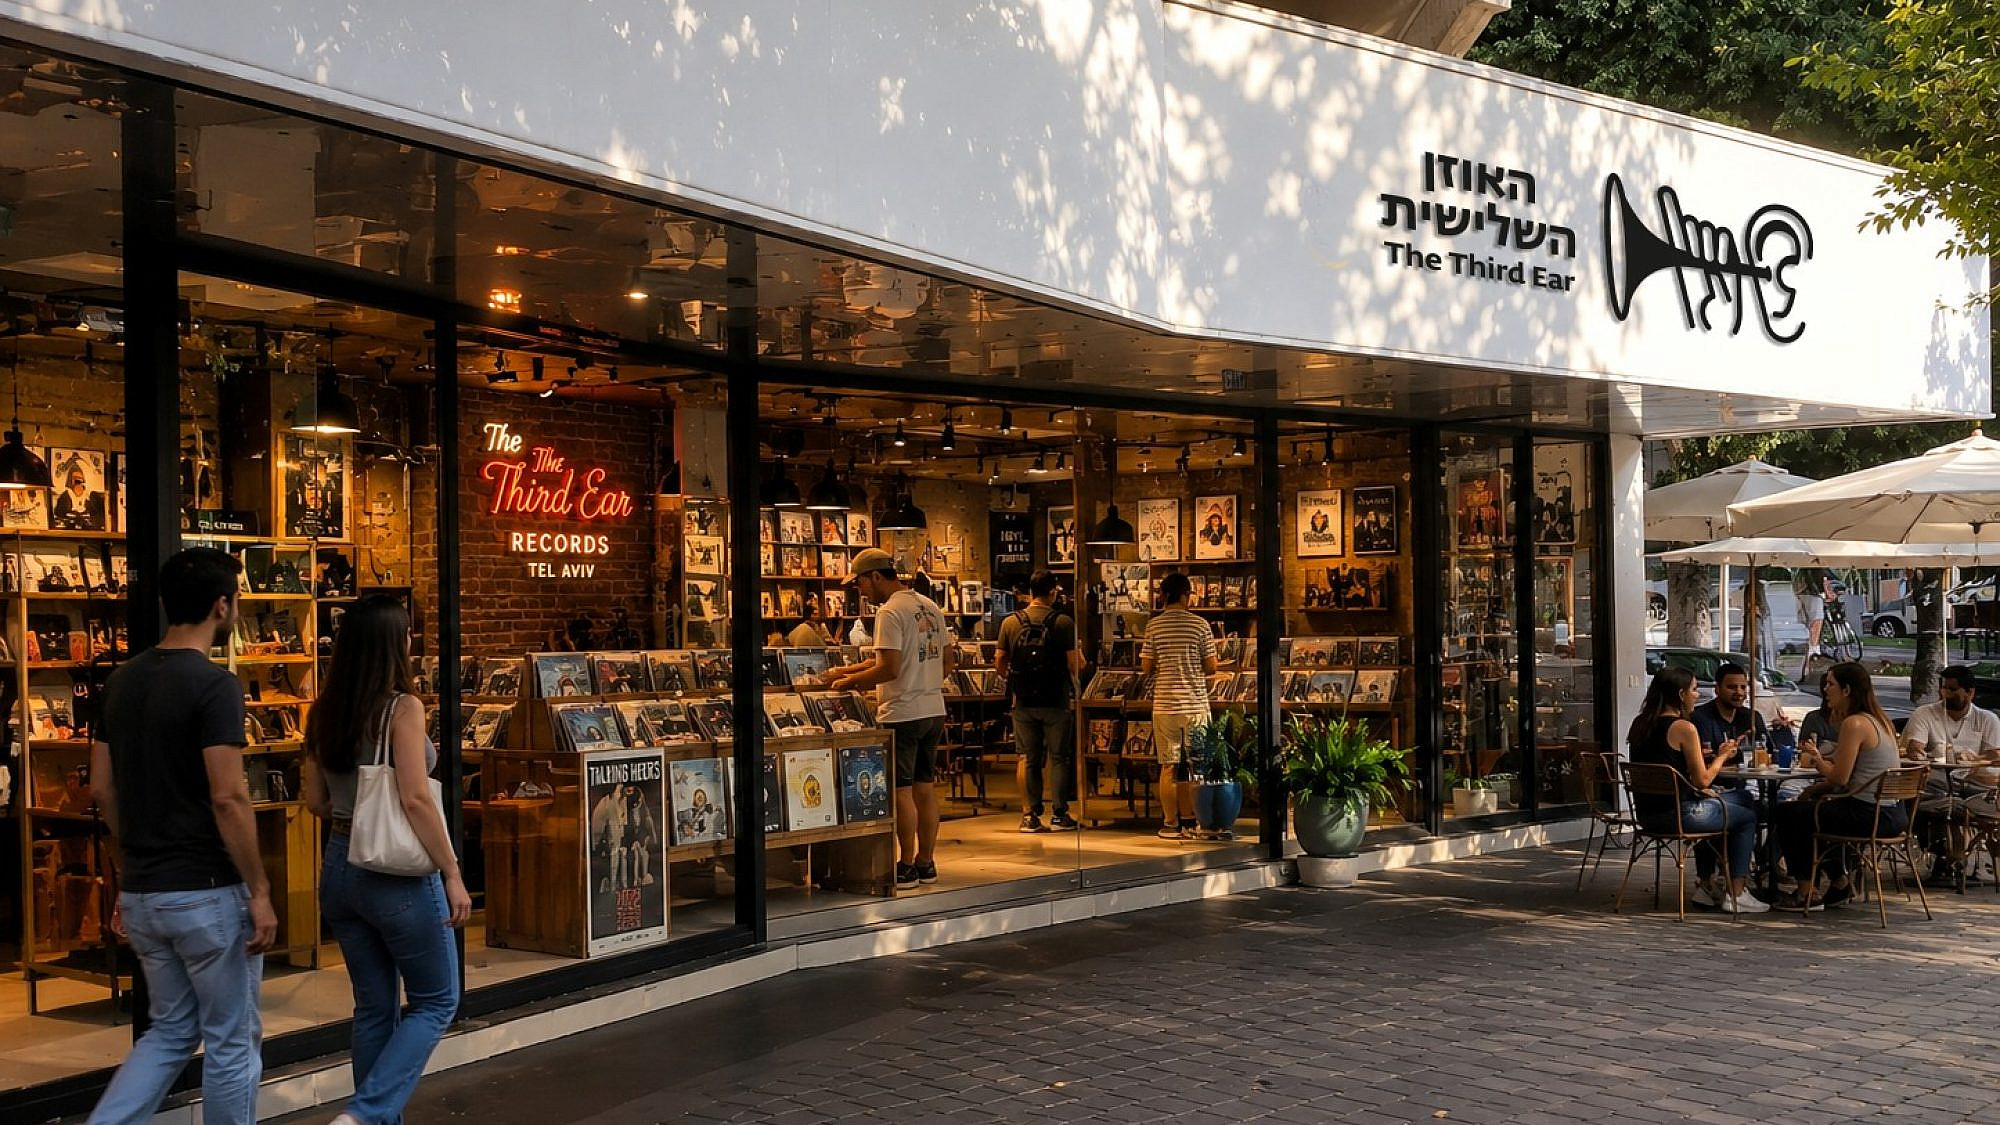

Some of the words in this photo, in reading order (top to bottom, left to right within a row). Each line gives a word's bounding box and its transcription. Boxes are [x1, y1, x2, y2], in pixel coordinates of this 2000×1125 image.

[1425, 152, 1536, 204] האוזן
[1380, 193, 1576, 258] השלישית
[1383, 240, 1442, 271] The
[1448, 251, 1526, 285] Third
[1533, 265, 1576, 292] Ear
[483, 422, 523, 452] The
[484, 461, 575, 515] Third
[580, 468, 634, 520] Ear
[511, 532, 610, 555] RECORDS
[528, 562, 556, 578] TEL
[561, 564, 595, 579] AVIV
